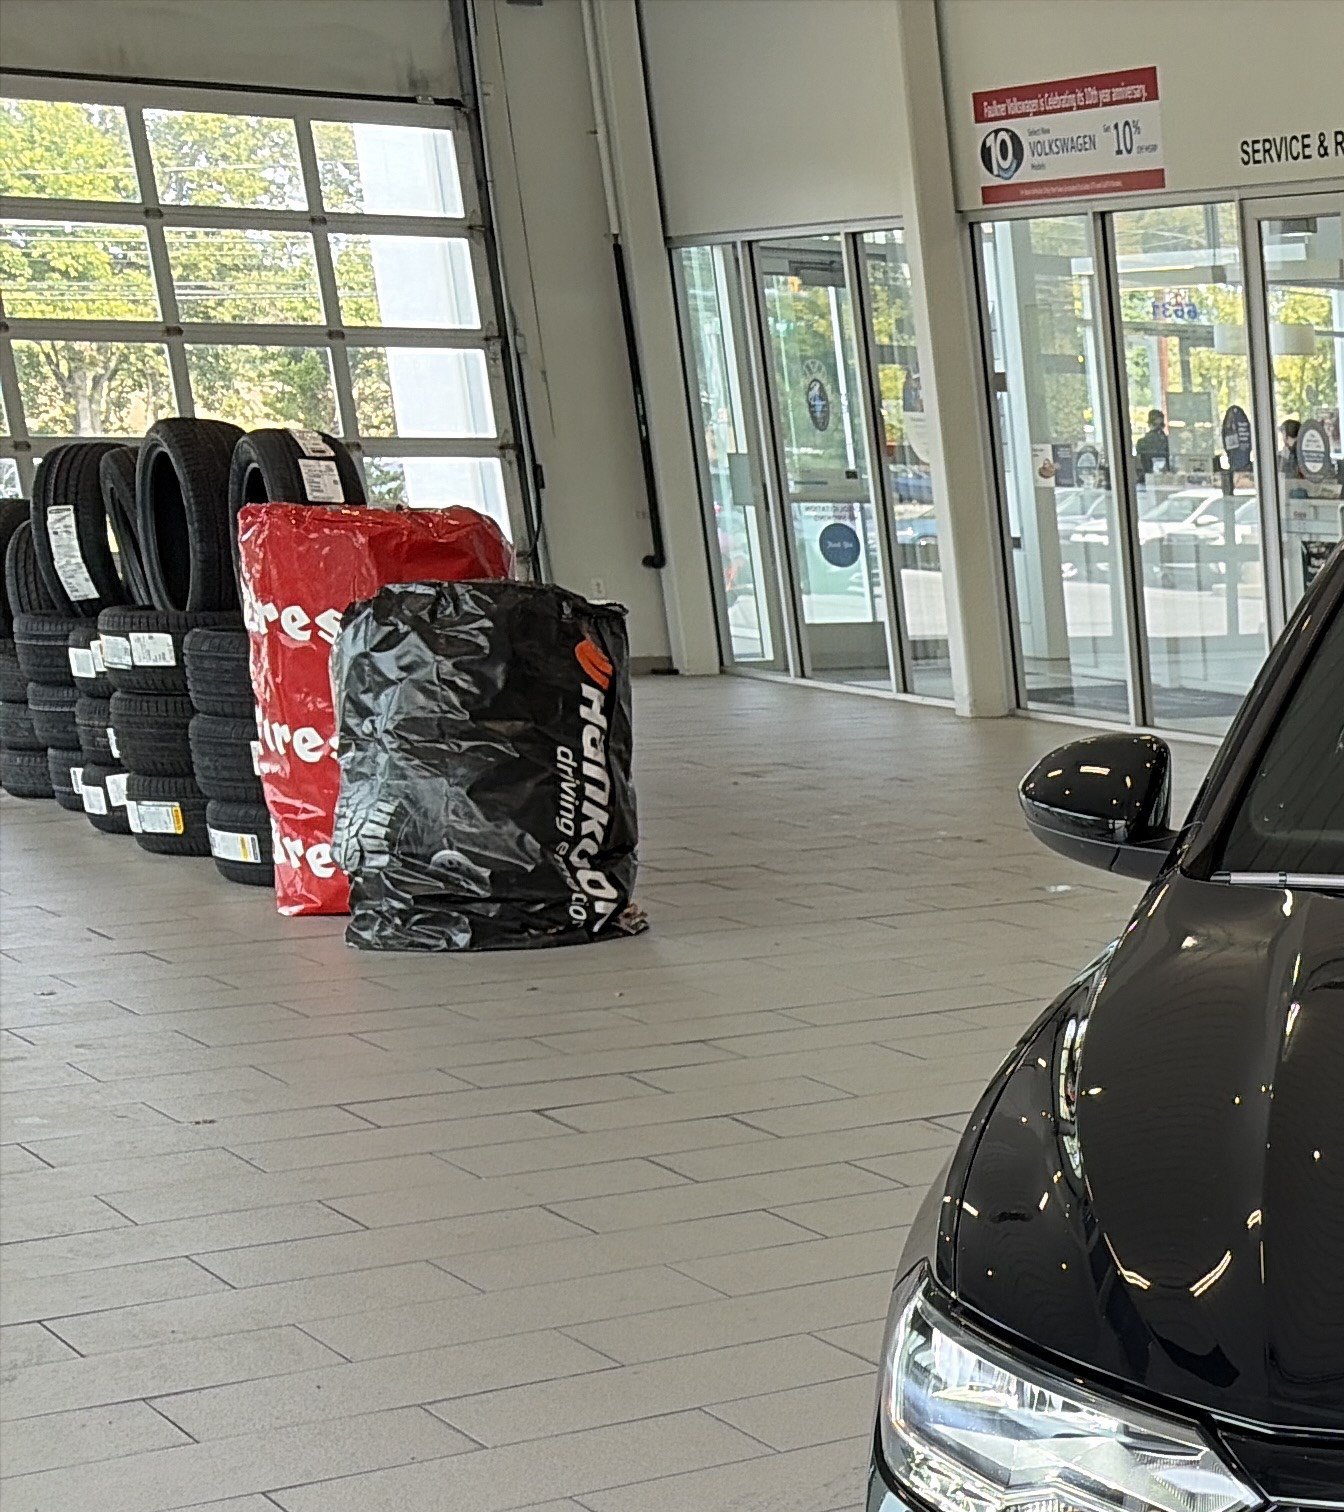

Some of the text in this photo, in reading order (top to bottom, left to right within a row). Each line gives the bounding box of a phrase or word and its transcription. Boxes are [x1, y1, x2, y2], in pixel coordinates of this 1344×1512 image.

[1029, 134, 1097, 158] VOLKSWAGEN
[1240, 134, 1312, 166] SERVICE
[1317, 132, 1330, 158] &
[556, 746, 578, 837] driving
